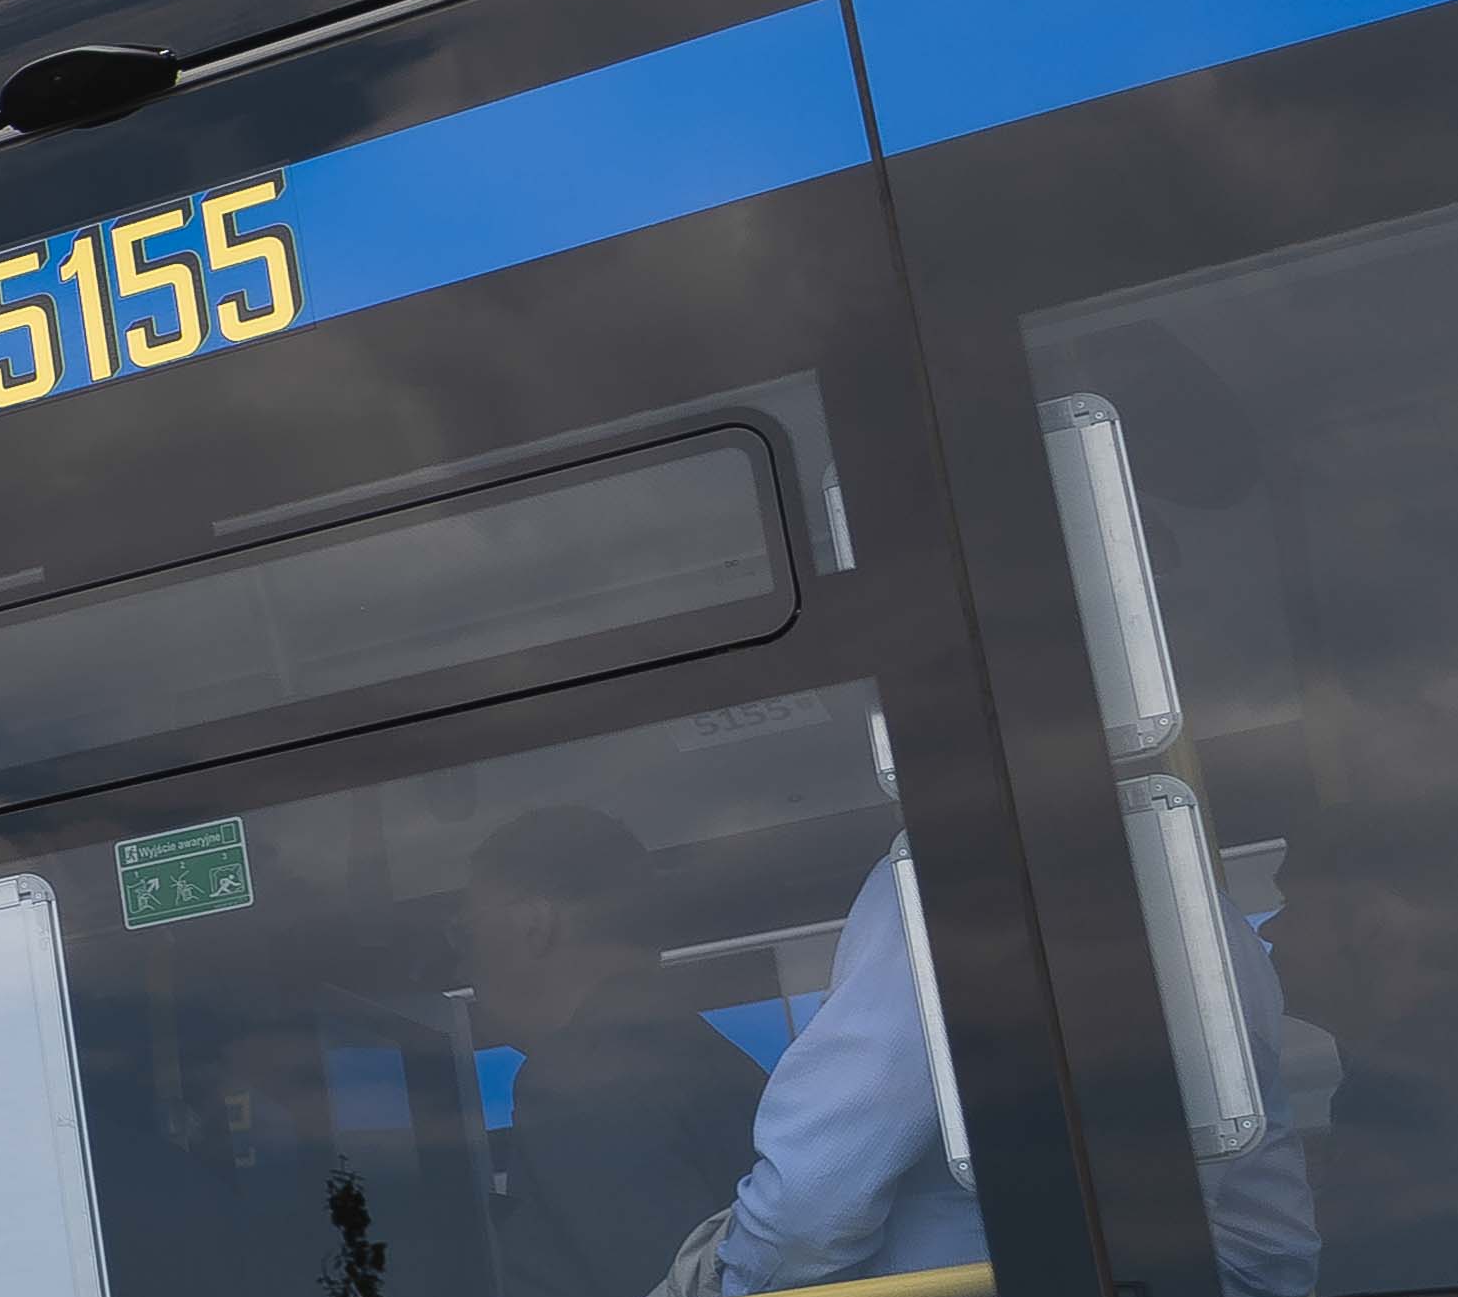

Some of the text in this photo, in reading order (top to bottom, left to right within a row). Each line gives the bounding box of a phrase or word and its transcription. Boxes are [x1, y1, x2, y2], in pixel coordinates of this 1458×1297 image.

[694, 702, 790, 737] 5155
[139, 833, 220, 858] Wyjście awaryjne
